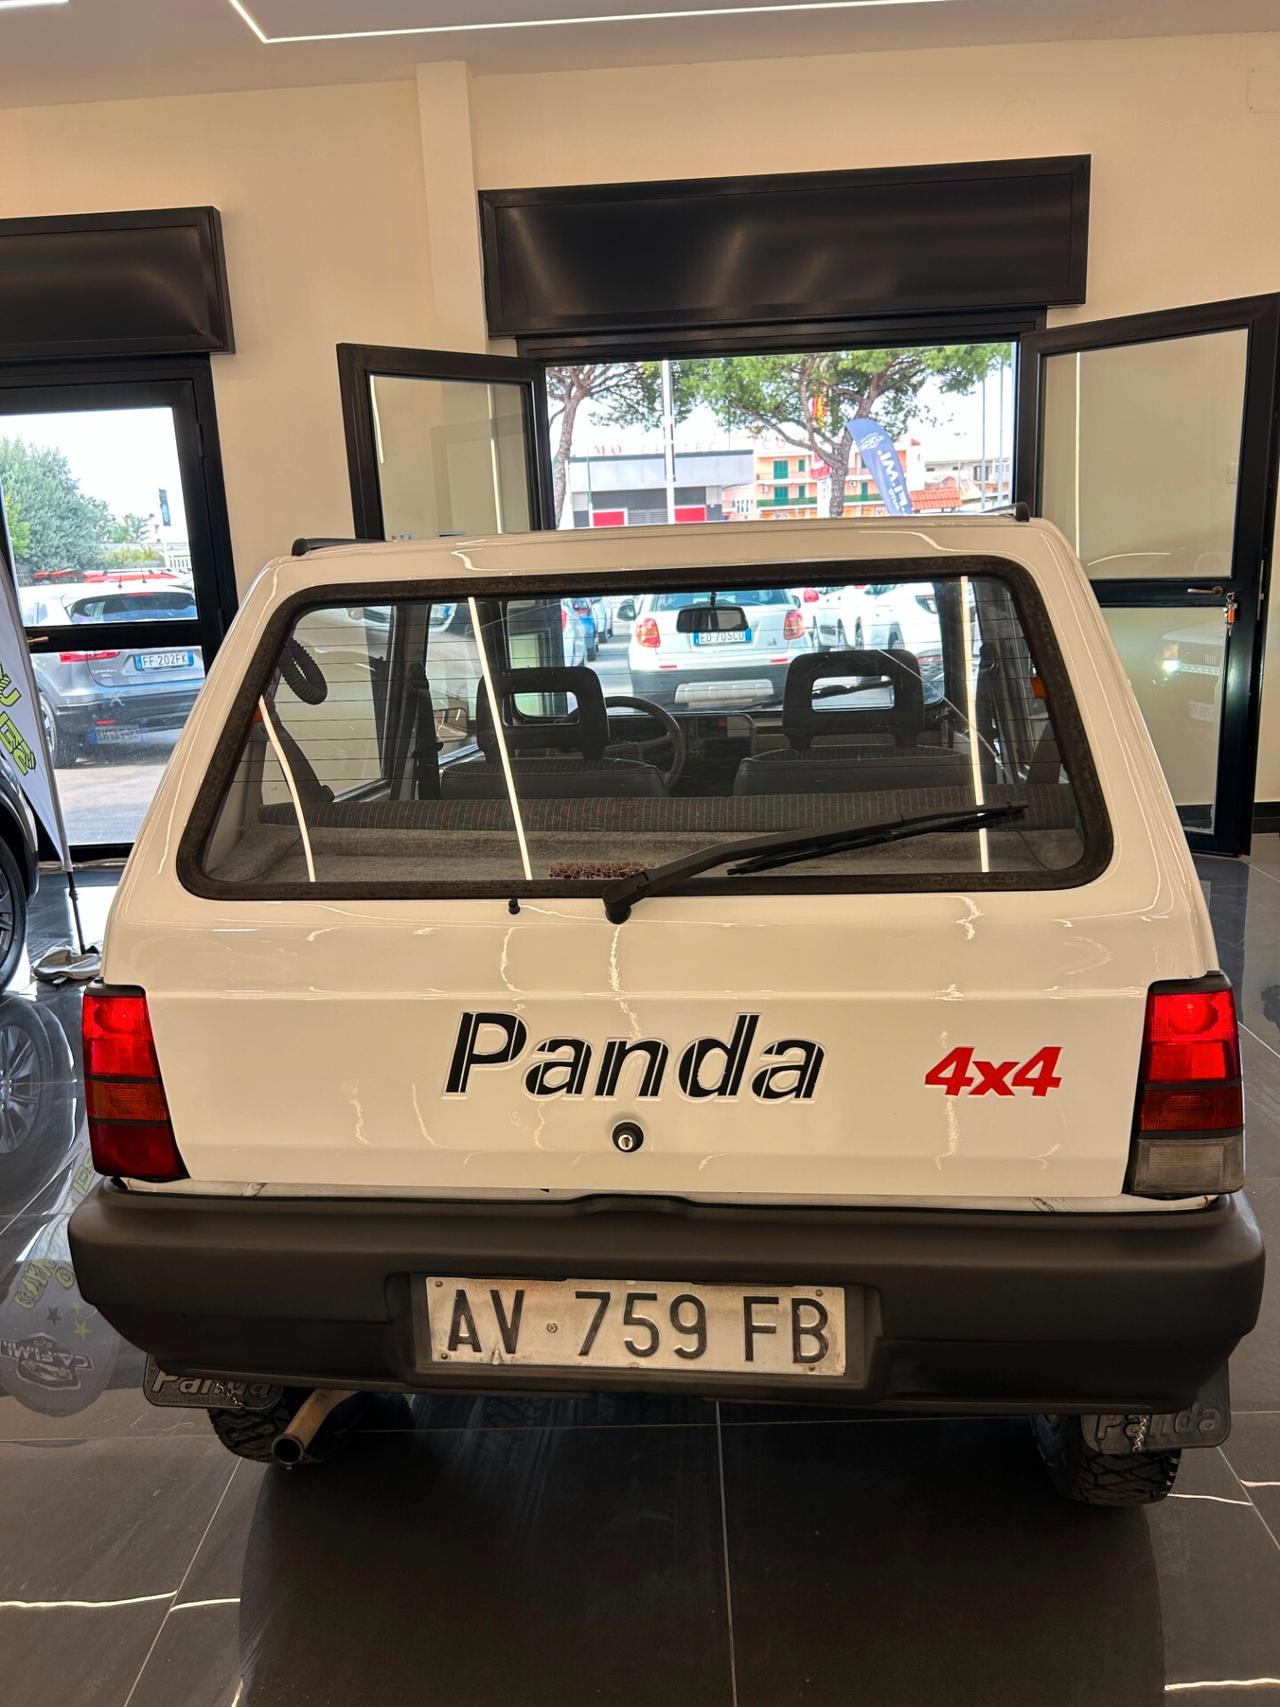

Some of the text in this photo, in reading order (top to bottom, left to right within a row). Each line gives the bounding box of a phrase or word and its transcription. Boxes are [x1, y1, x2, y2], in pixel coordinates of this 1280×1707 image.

[142, 653, 187, 667] FF 202FK
[443, 1011, 828, 1103] Panda
[924, 1046, 1062, 1097] 4x4
[447, 1289, 830, 1364] AV 759 FB
